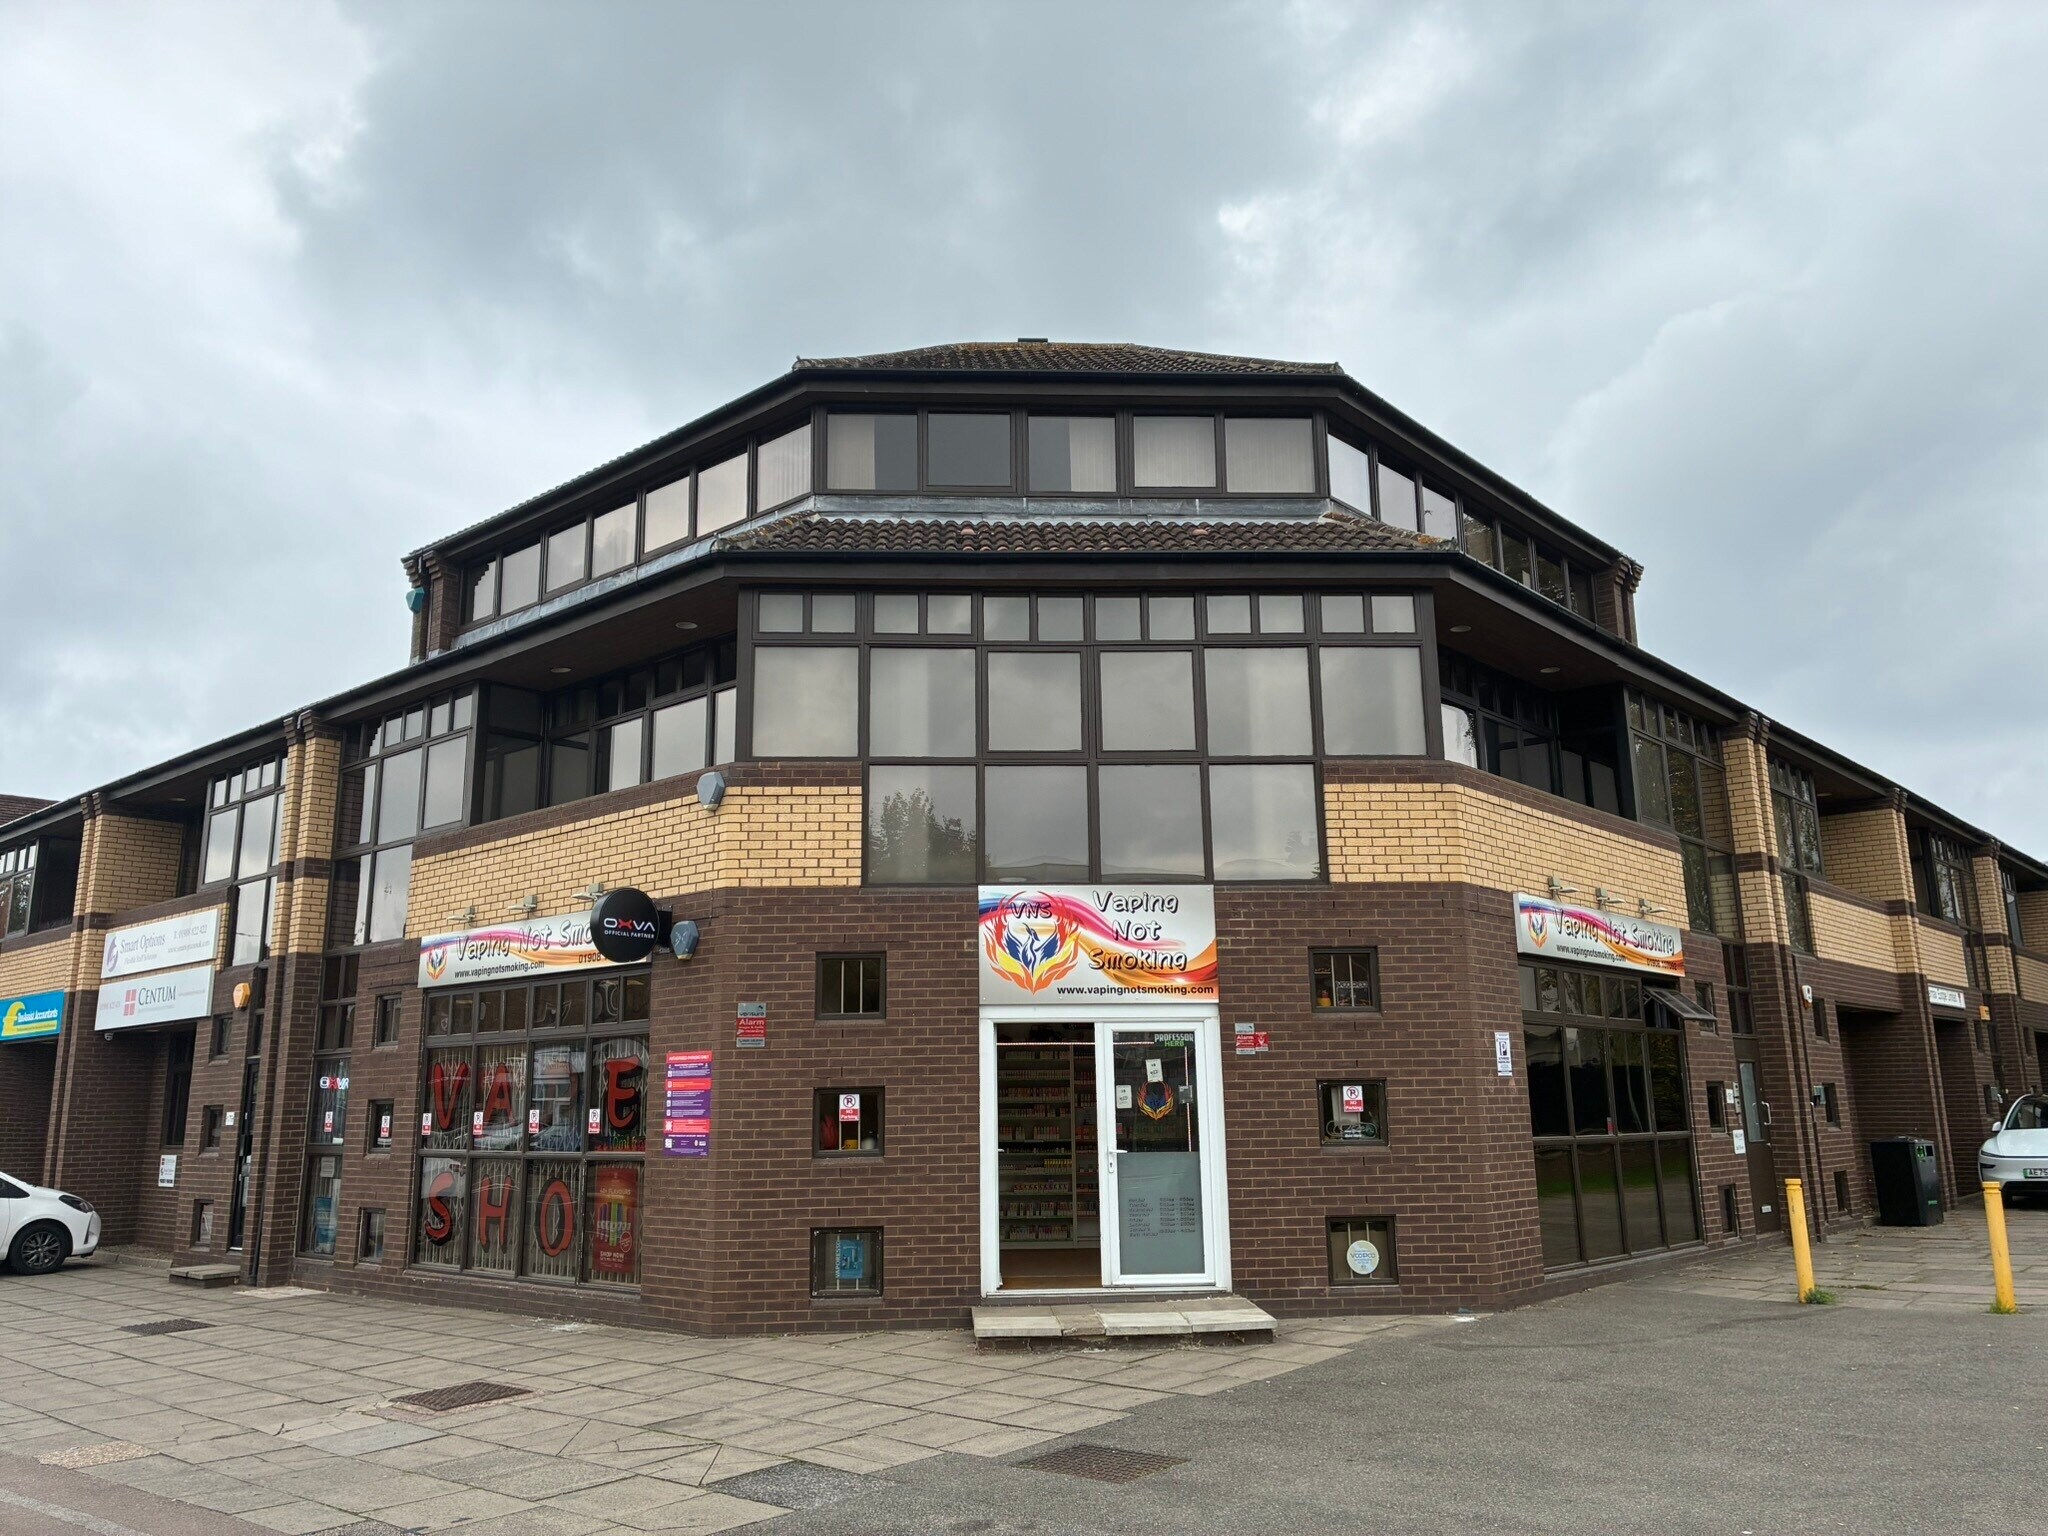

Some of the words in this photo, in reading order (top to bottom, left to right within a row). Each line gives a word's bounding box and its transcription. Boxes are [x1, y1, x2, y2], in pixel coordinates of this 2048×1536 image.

[1010, 901, 1053, 919] VNS
[1092, 890, 1179, 914] Vaping
[603, 917, 656, 932] OXVA
[603, 929, 630, 937] OFFICIAL
[630, 931, 655, 939] PARTNER
[1111, 919, 1162, 941] Not
[1552, 906, 1599, 943] Vaping
[1602, 917, 1627, 946] Not
[1630, 922, 1675, 957] Smoking
[119, 938, 140, 954] Smart
[140, 932, 166, 952] Options
[456, 932, 512, 962] Vaping
[518, 923, 553, 955] Not
[454, 960, 545, 979] www.vapingnotsmoking.com
[1087, 948, 1188, 971] Smoking
[1056, 985, 1214, 996] www.vapingnotsmoking.com
[1154, 1033, 1194, 1042] PROFESSOR
[433, 1055, 643, 1134] VAE
